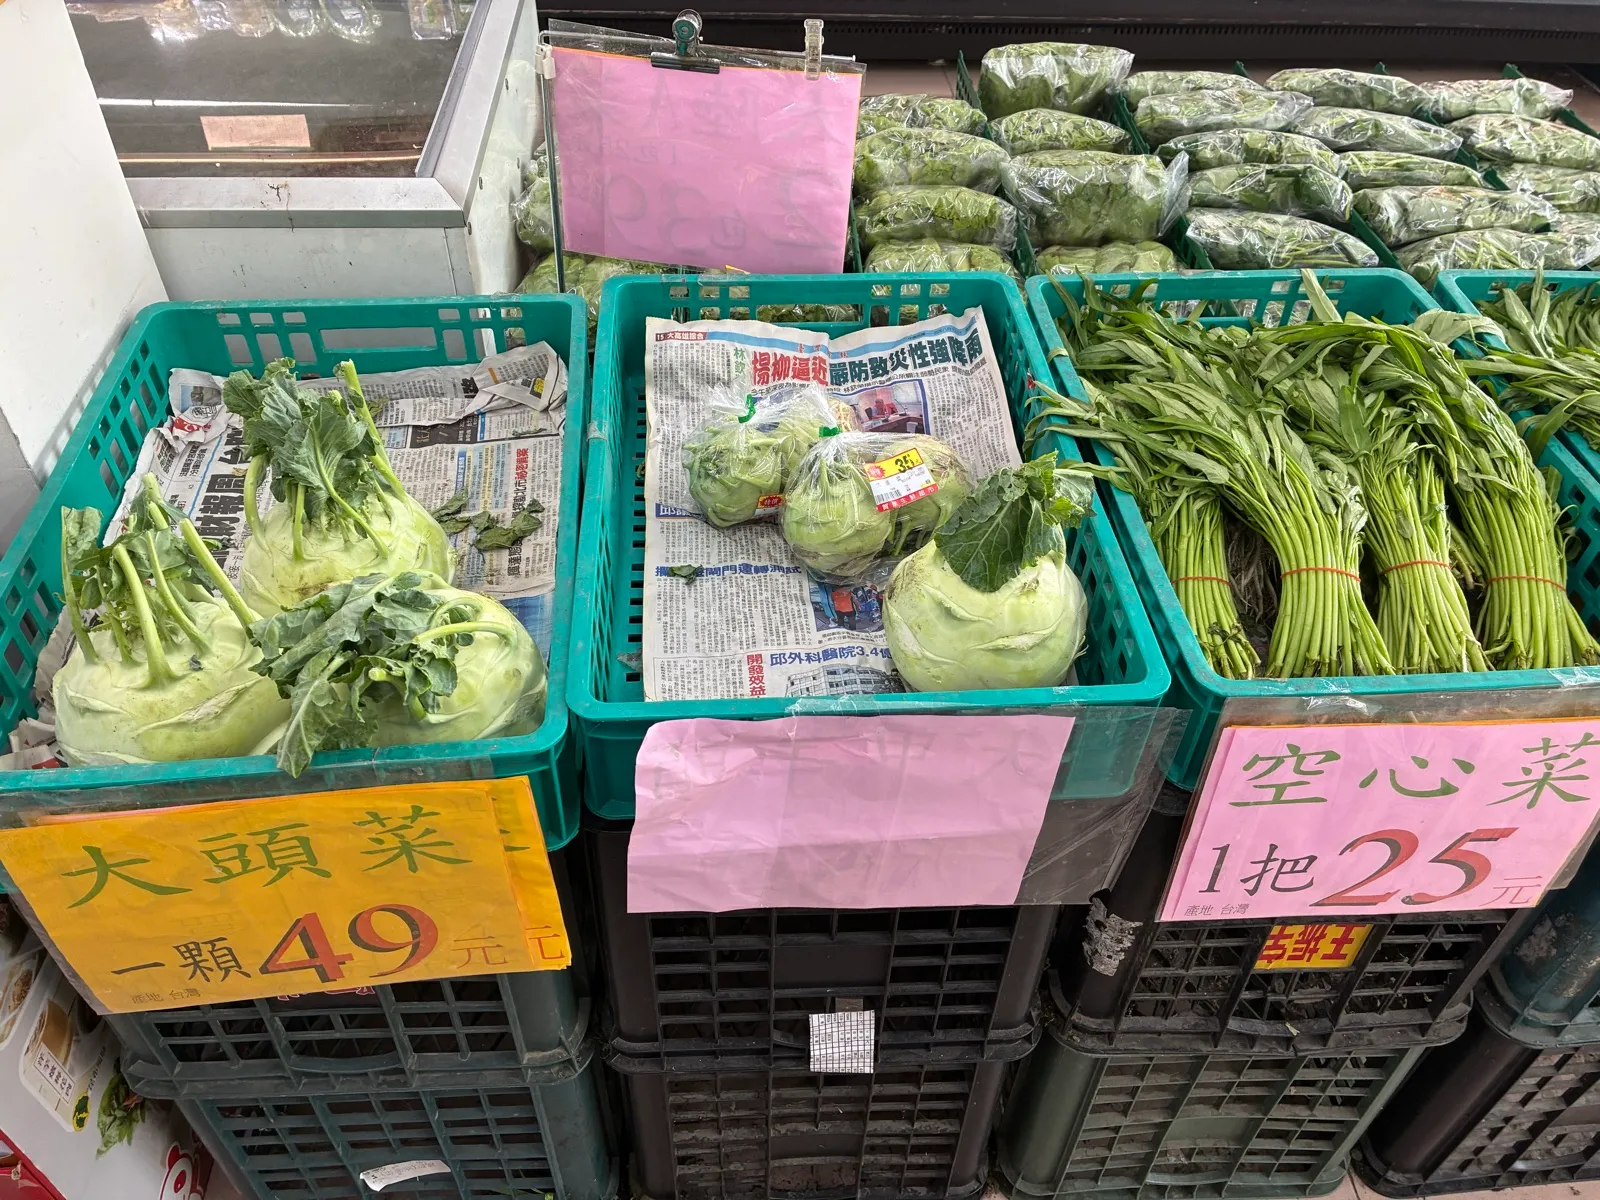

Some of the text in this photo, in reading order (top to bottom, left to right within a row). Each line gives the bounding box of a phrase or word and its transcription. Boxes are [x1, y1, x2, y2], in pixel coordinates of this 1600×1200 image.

[734, 347, 746, 377] 林欽
[752, 328, 984, 387] 楊柳逼近 嚴防致災性強降雨
[655, 563, 803, 577] 攔閘門運轉測試
[1228, 732, 1600, 810] 空心菜
[61, 804, 473, 909] 大頭菜
